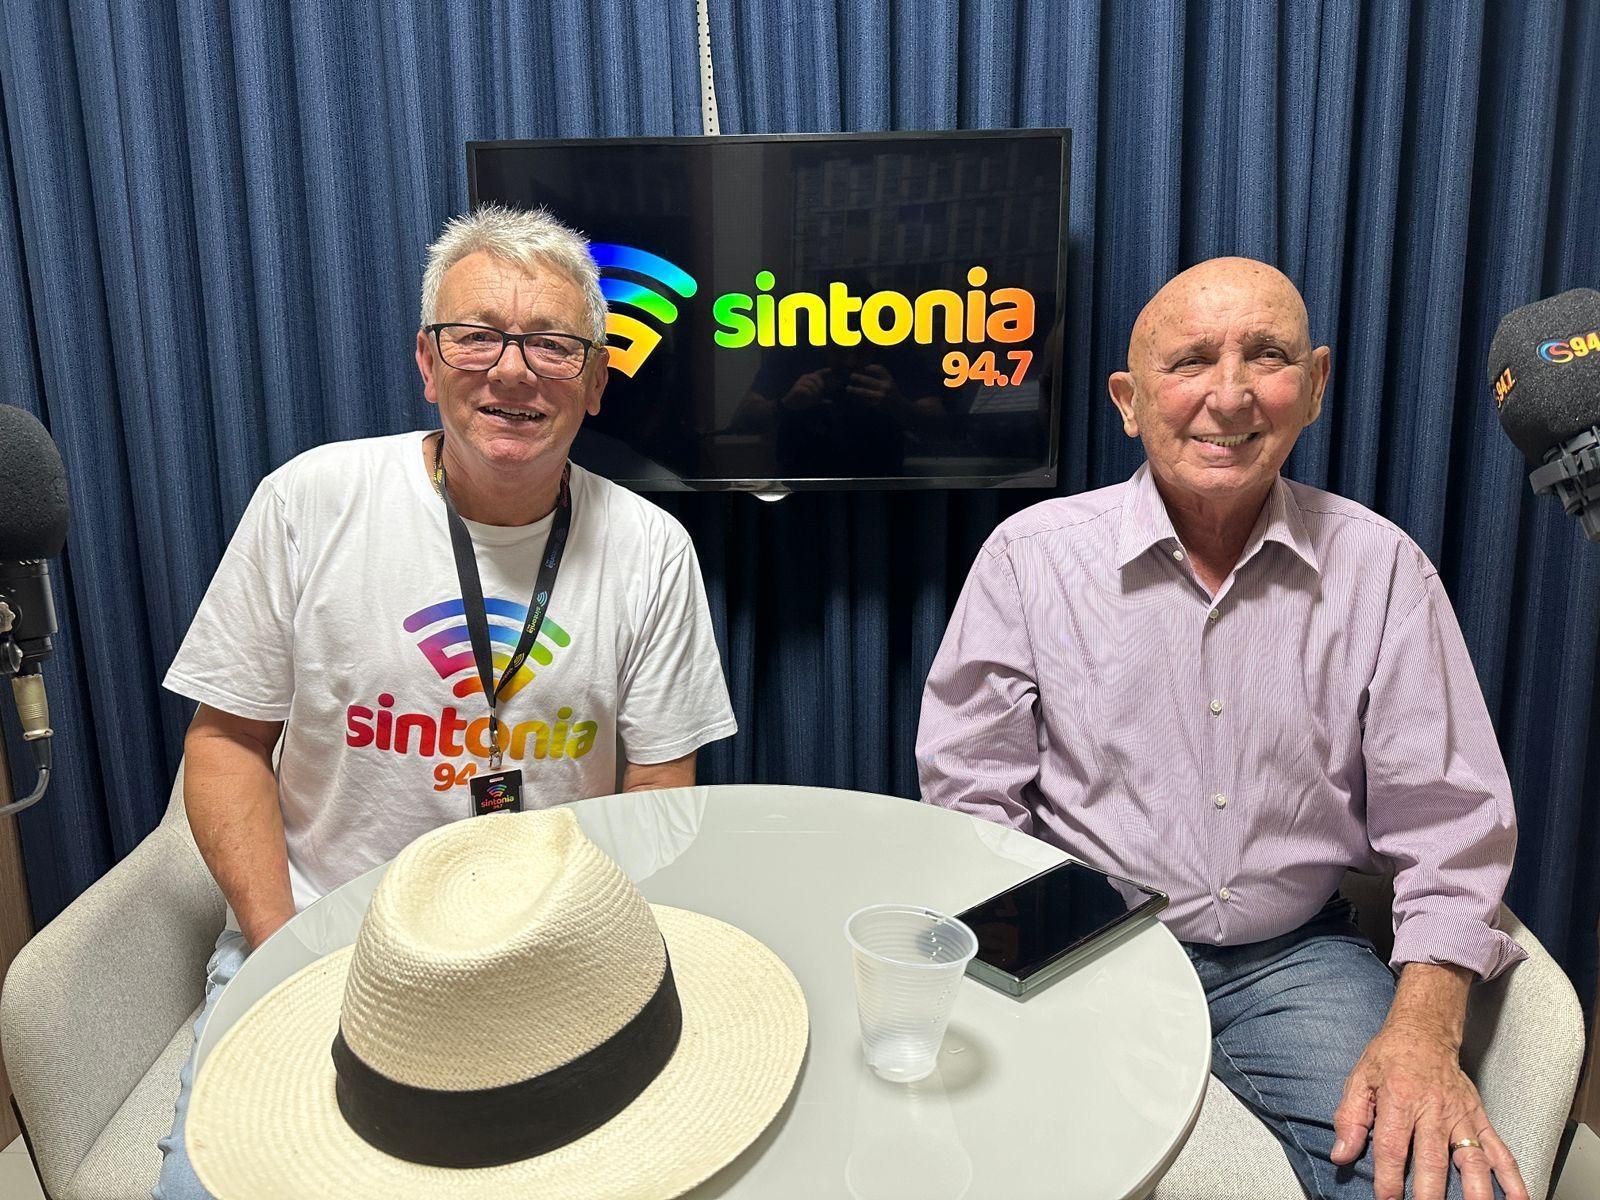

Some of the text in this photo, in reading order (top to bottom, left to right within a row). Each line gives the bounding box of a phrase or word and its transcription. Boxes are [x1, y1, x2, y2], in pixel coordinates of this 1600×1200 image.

[713, 266, 1035, 348] sintonia
[942, 350, 1033, 387] 94.7
[346, 693, 598, 760] sintonia
[481, 795, 514, 807] sintonia
